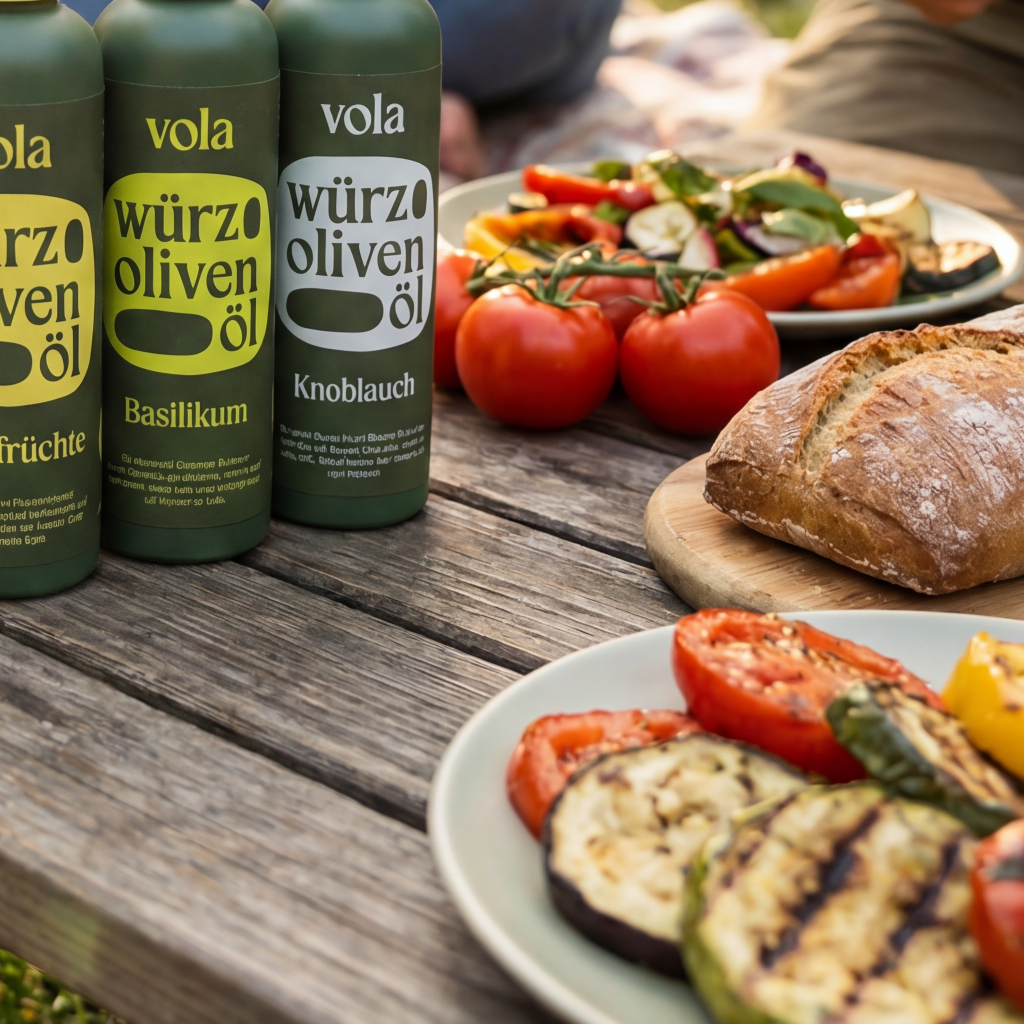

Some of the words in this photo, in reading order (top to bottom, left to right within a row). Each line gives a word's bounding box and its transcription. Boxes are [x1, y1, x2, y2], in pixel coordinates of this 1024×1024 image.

[146, 108, 233, 151] vola
[321, 93, 404, 135] vola
[114, 194, 239, 242] würz
[286, 177, 407, 223] würz
[114, 246, 257, 299] oliven
[286, 228, 423, 277] oliven
[220, 298, 257, 351] öl
[389, 275, 423, 329] öl
[40, 324, 80, 382] öl
[295, 372, 414, 402] Knoblauch
[126, 398, 247, 427] Basilikum
